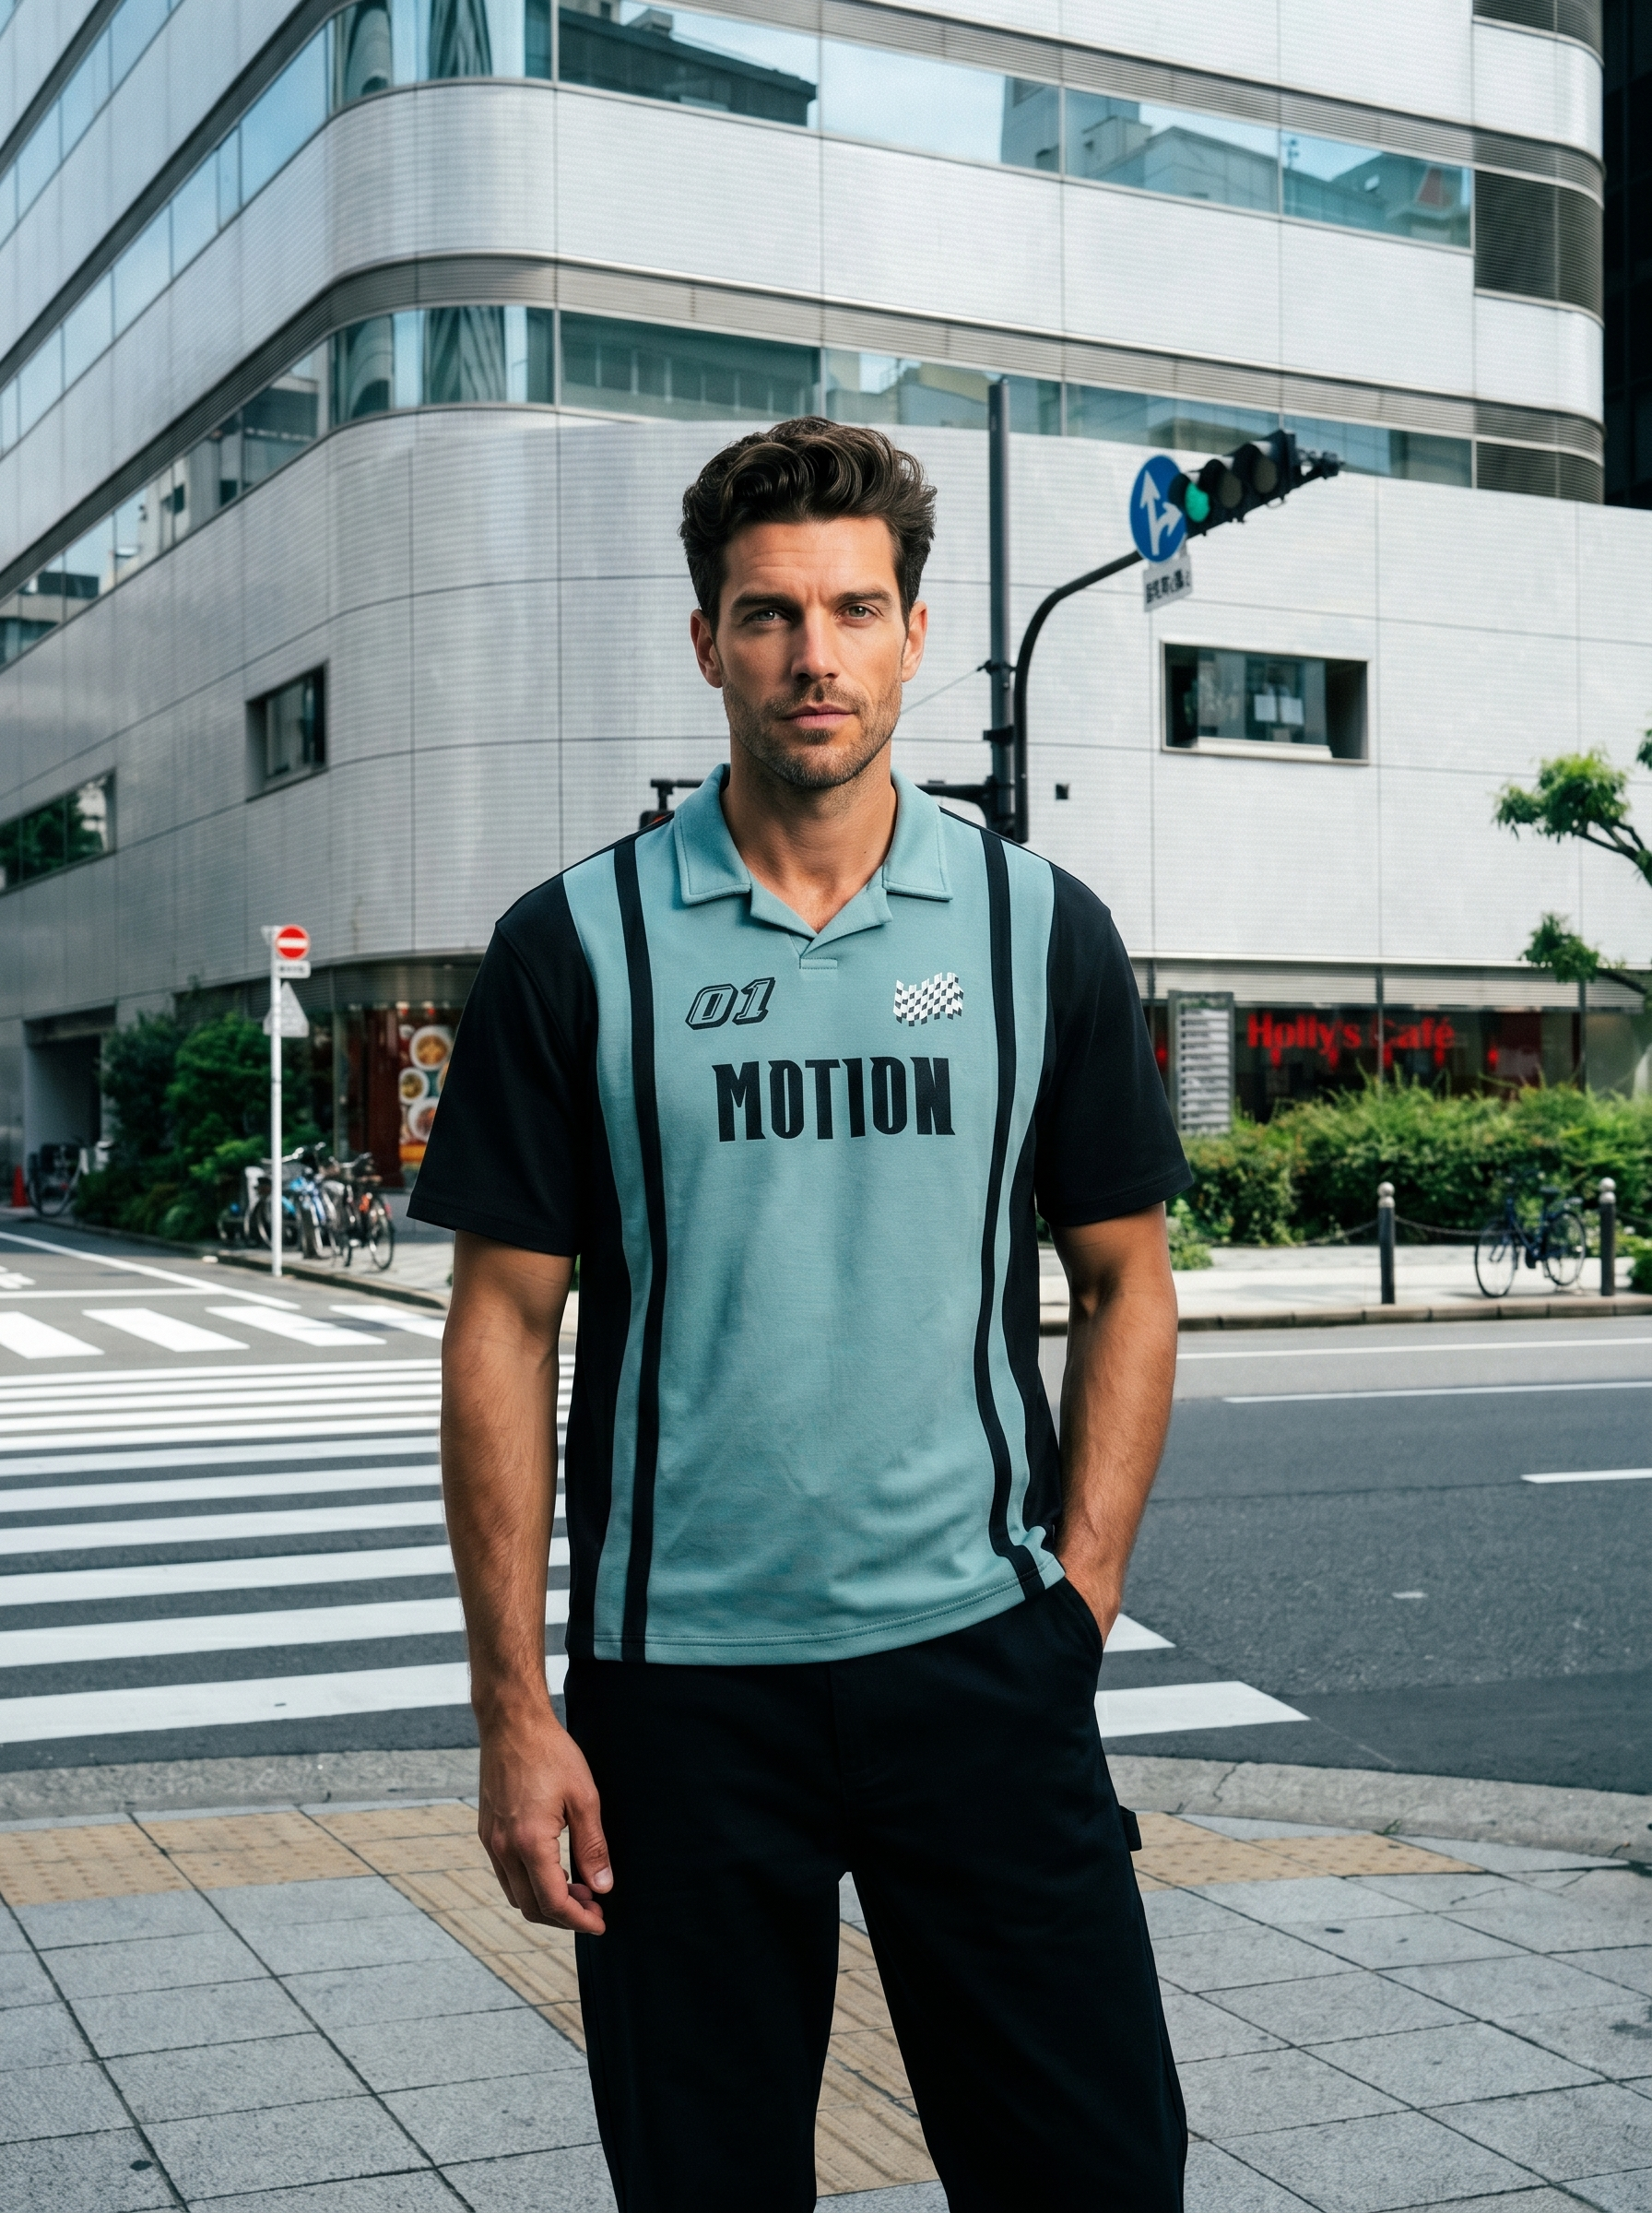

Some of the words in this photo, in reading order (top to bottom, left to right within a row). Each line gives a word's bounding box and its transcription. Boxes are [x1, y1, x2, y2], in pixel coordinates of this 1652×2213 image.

[685, 976, 775, 1030] 01
[1247, 1012, 1362, 1055] Holly's
[712, 1057, 956, 1142] MOTION
